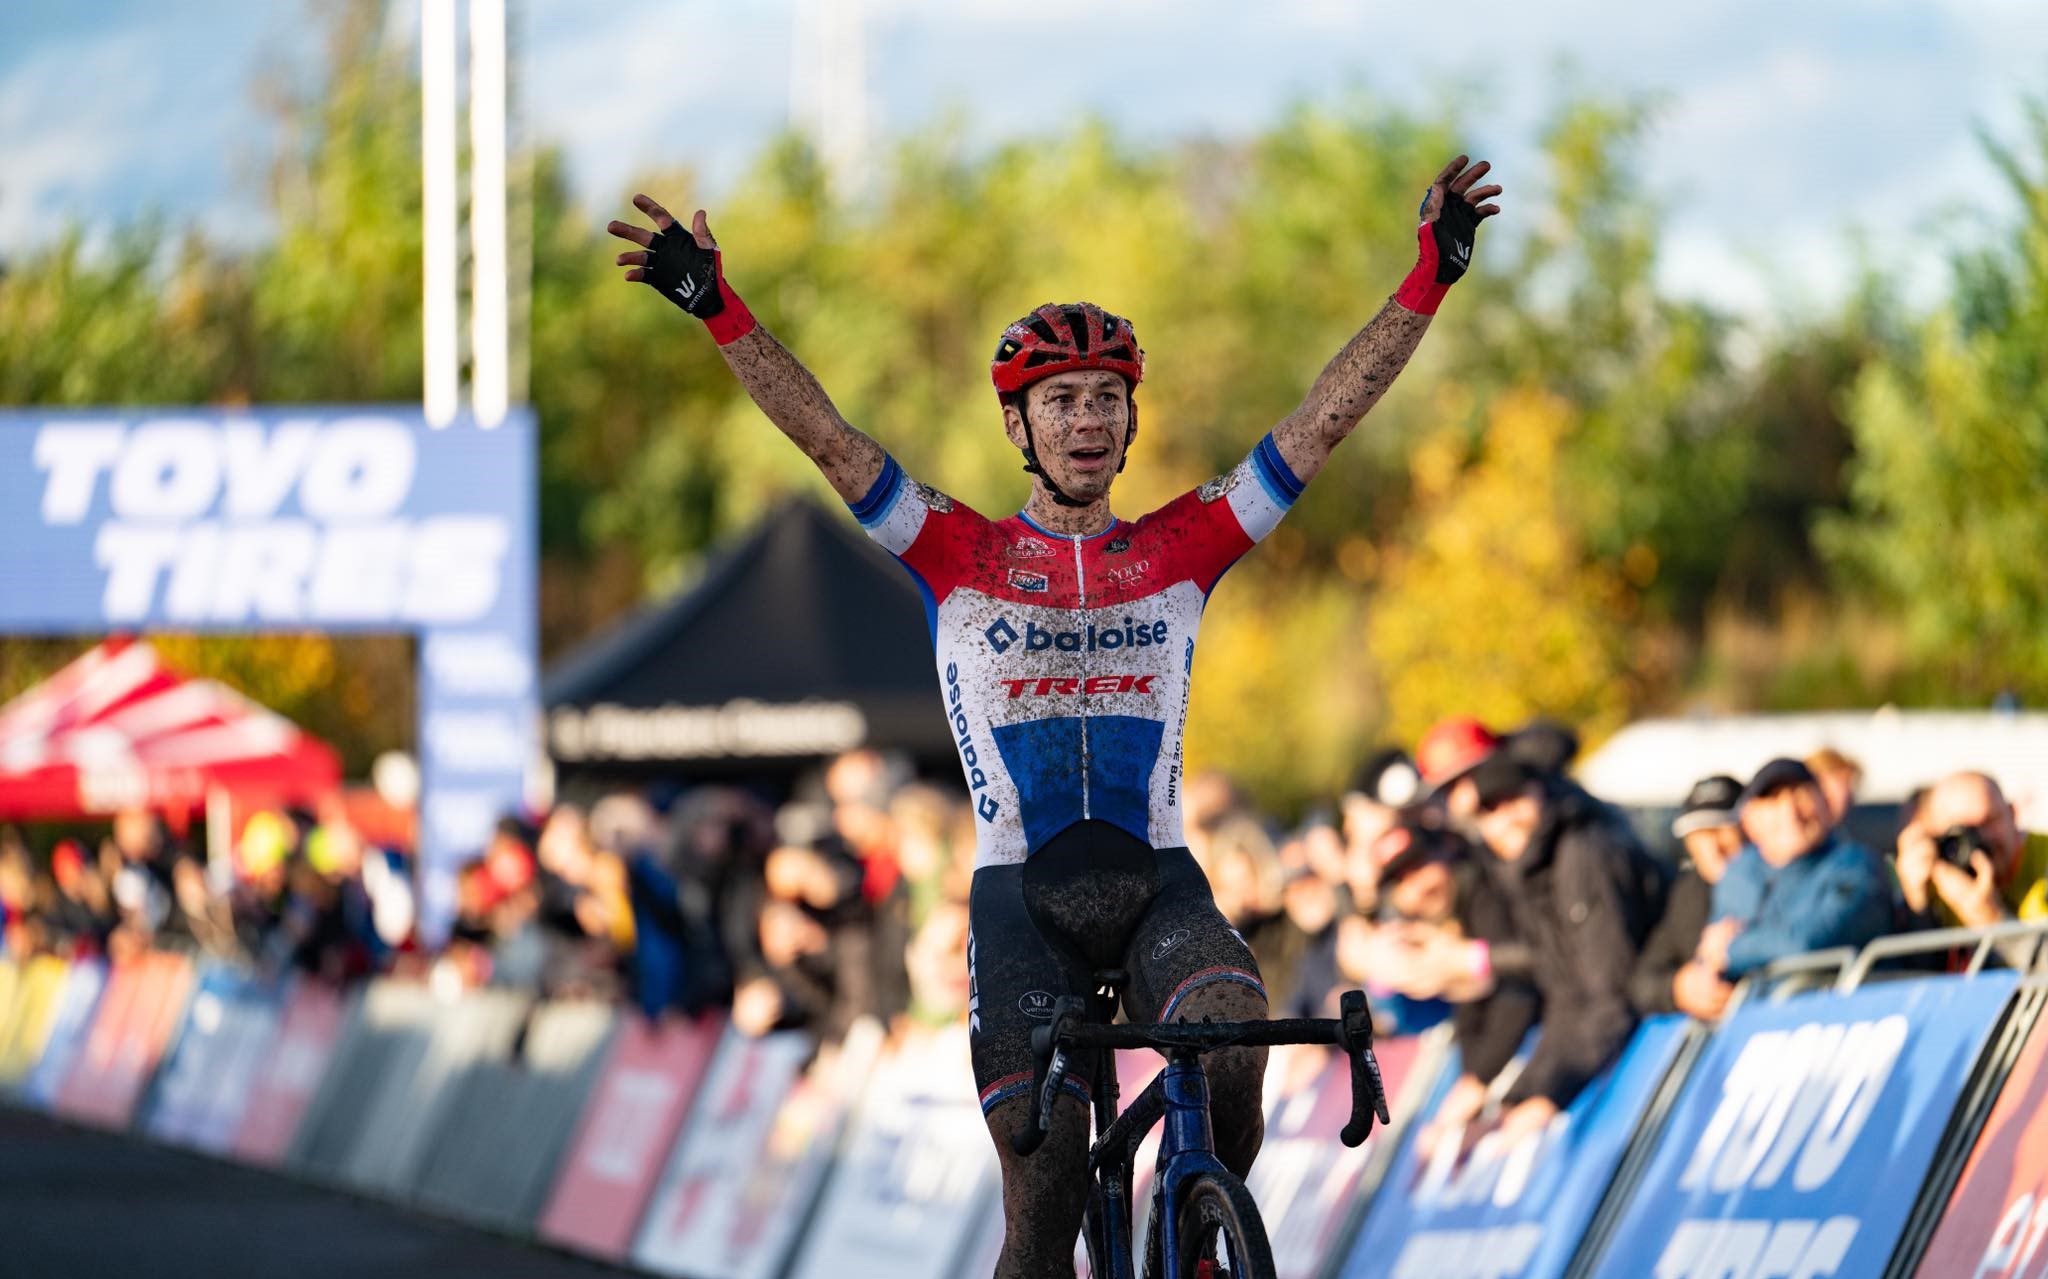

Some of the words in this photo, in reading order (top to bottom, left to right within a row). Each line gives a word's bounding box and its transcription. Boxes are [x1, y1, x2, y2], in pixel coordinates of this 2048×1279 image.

[33, 417, 417, 524] TOYO
[94, 515, 508, 623] TIRES
[1000, 675, 1159, 700] TREK
[1025, 617, 1168, 652] baloise
[946, 662, 988, 792] baloise
[1168, 765, 1179, 808] BAINS
[1676, 1014, 1909, 1193] TOYO
